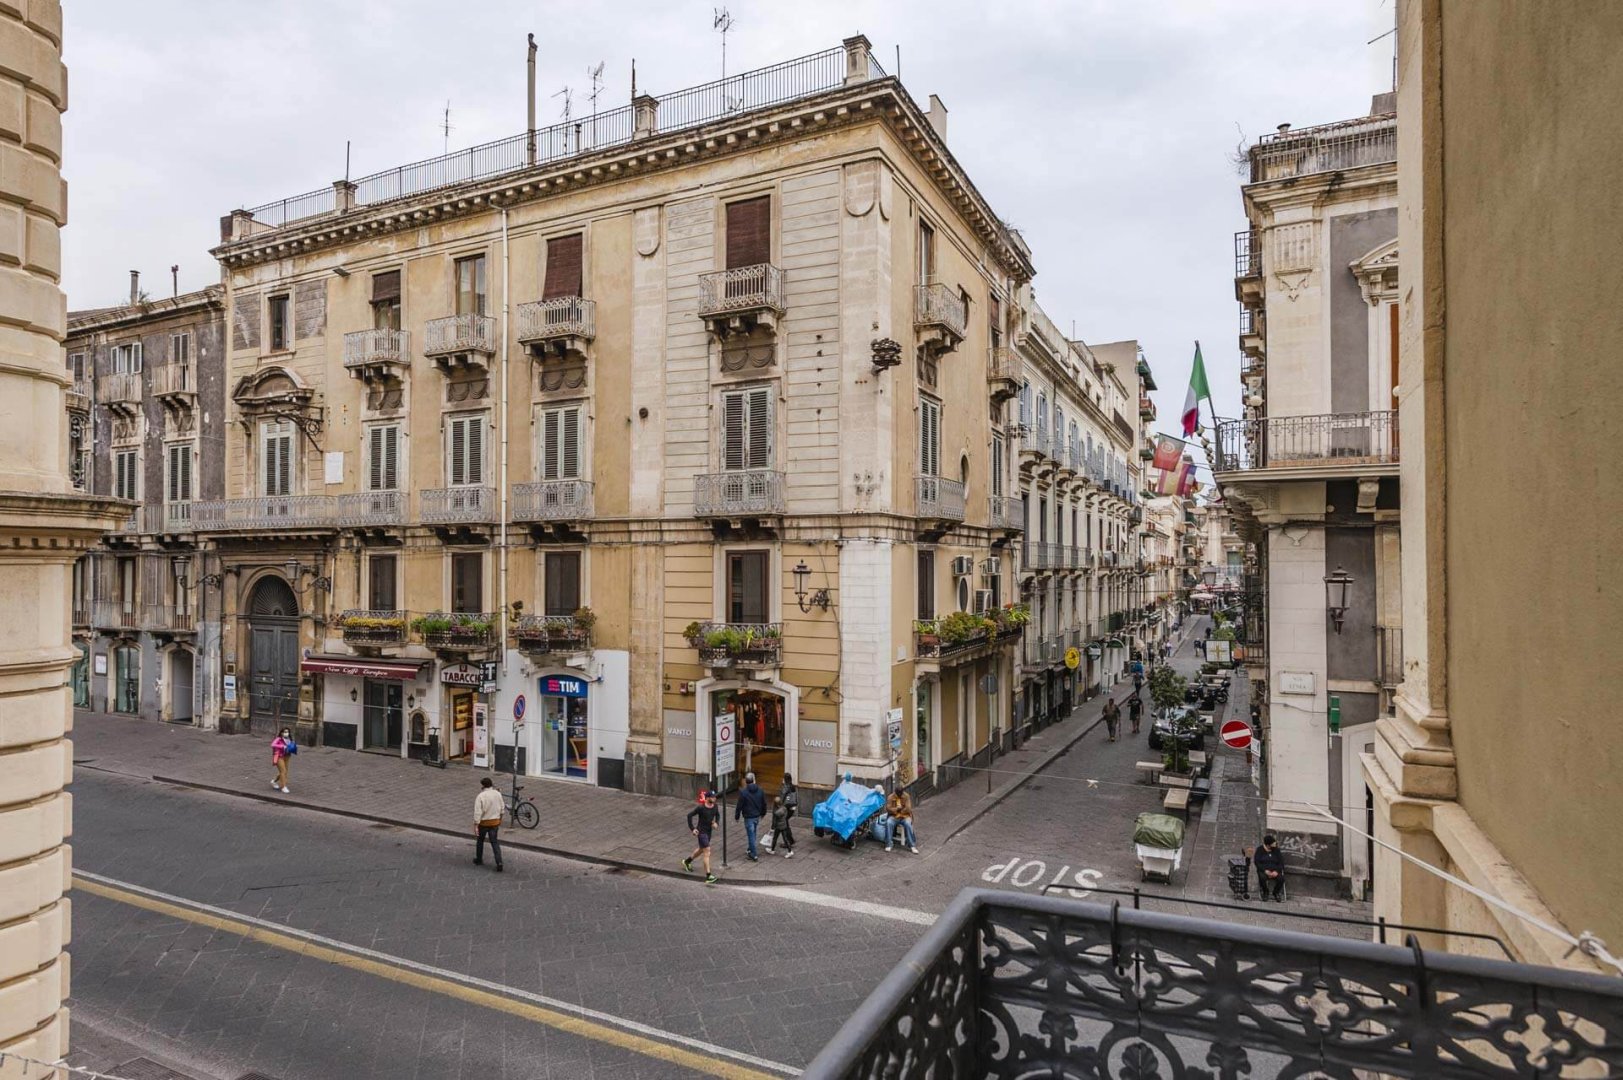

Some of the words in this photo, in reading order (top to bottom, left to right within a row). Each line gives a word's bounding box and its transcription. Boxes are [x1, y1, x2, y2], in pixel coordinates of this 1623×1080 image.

[443, 672, 480, 683] TABACCH
[559, 681, 580, 693] TIM
[667, 727, 692, 736] VANTO
[803, 738, 833, 749] VANTO
[981, 857, 1104, 898] STOP
